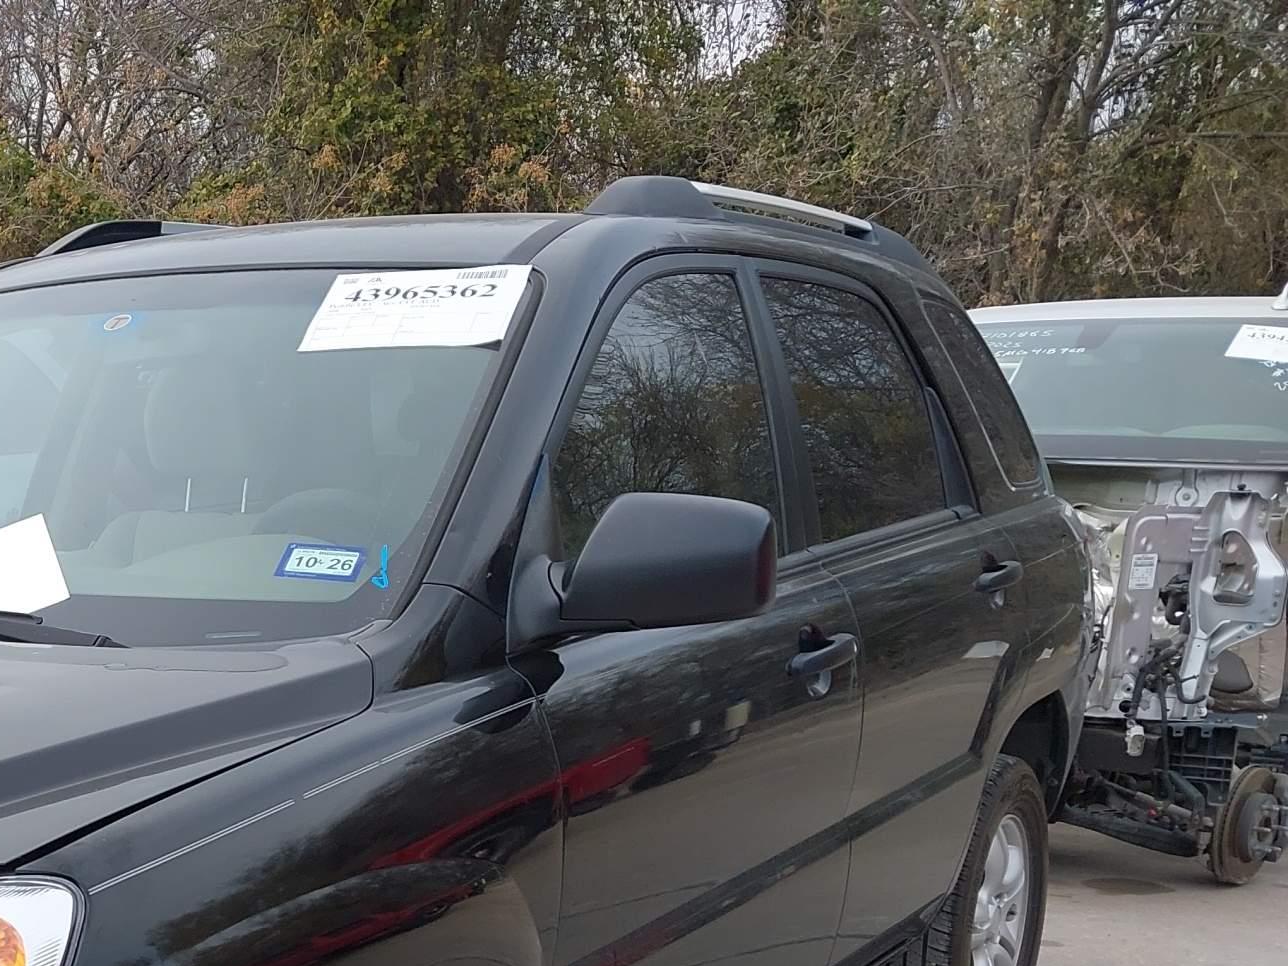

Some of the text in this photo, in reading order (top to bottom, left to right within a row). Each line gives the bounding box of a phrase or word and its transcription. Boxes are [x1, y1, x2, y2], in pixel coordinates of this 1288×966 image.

[344, 283, 499, 302] 43965362
[295, 555, 354, 571] 10 26
